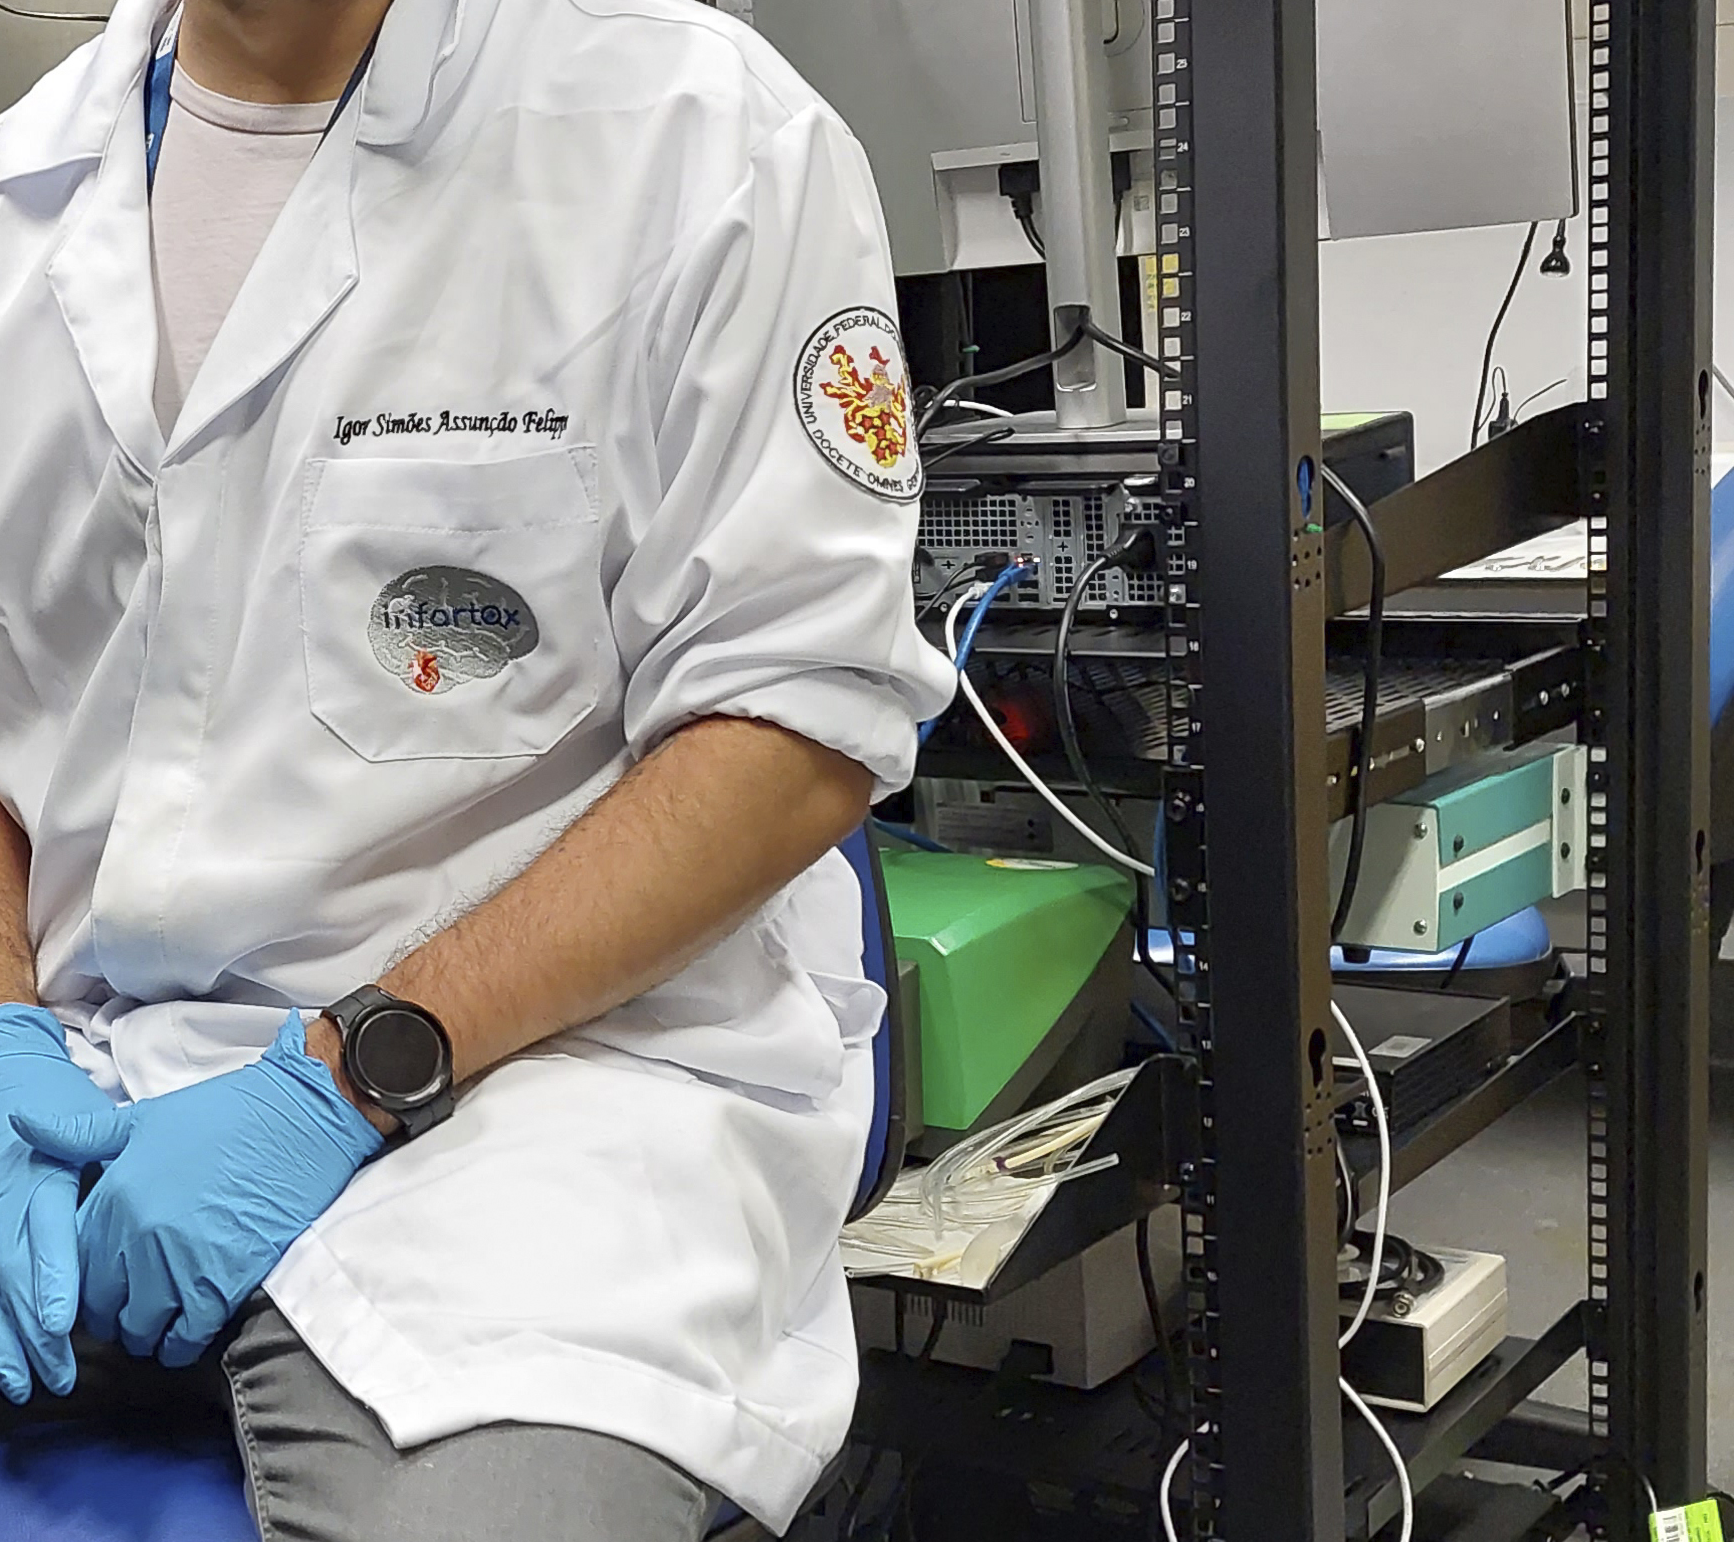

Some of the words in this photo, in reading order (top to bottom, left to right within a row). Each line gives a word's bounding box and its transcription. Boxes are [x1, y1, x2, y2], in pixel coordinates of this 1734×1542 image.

[1177, 141, 1189, 152] 24
[1181, 312, 1192, 321] 22
[800, 331, 835, 425] UNIVERSIDADE
[833, 315, 884, 338] FEDERAL
[1182, 395, 1193, 405] 21
[333, 415, 372, 445] Igor
[373, 412, 432, 437] Simões
[433, 410, 517, 438] Assunção
[813, 429, 862, 478] DOCETE
[867, 472, 904, 493] OMNES
[1187, 560, 1198, 570] 19
[1192, 722, 1202, 733] 17
[1199, 961, 1209, 972] 14
